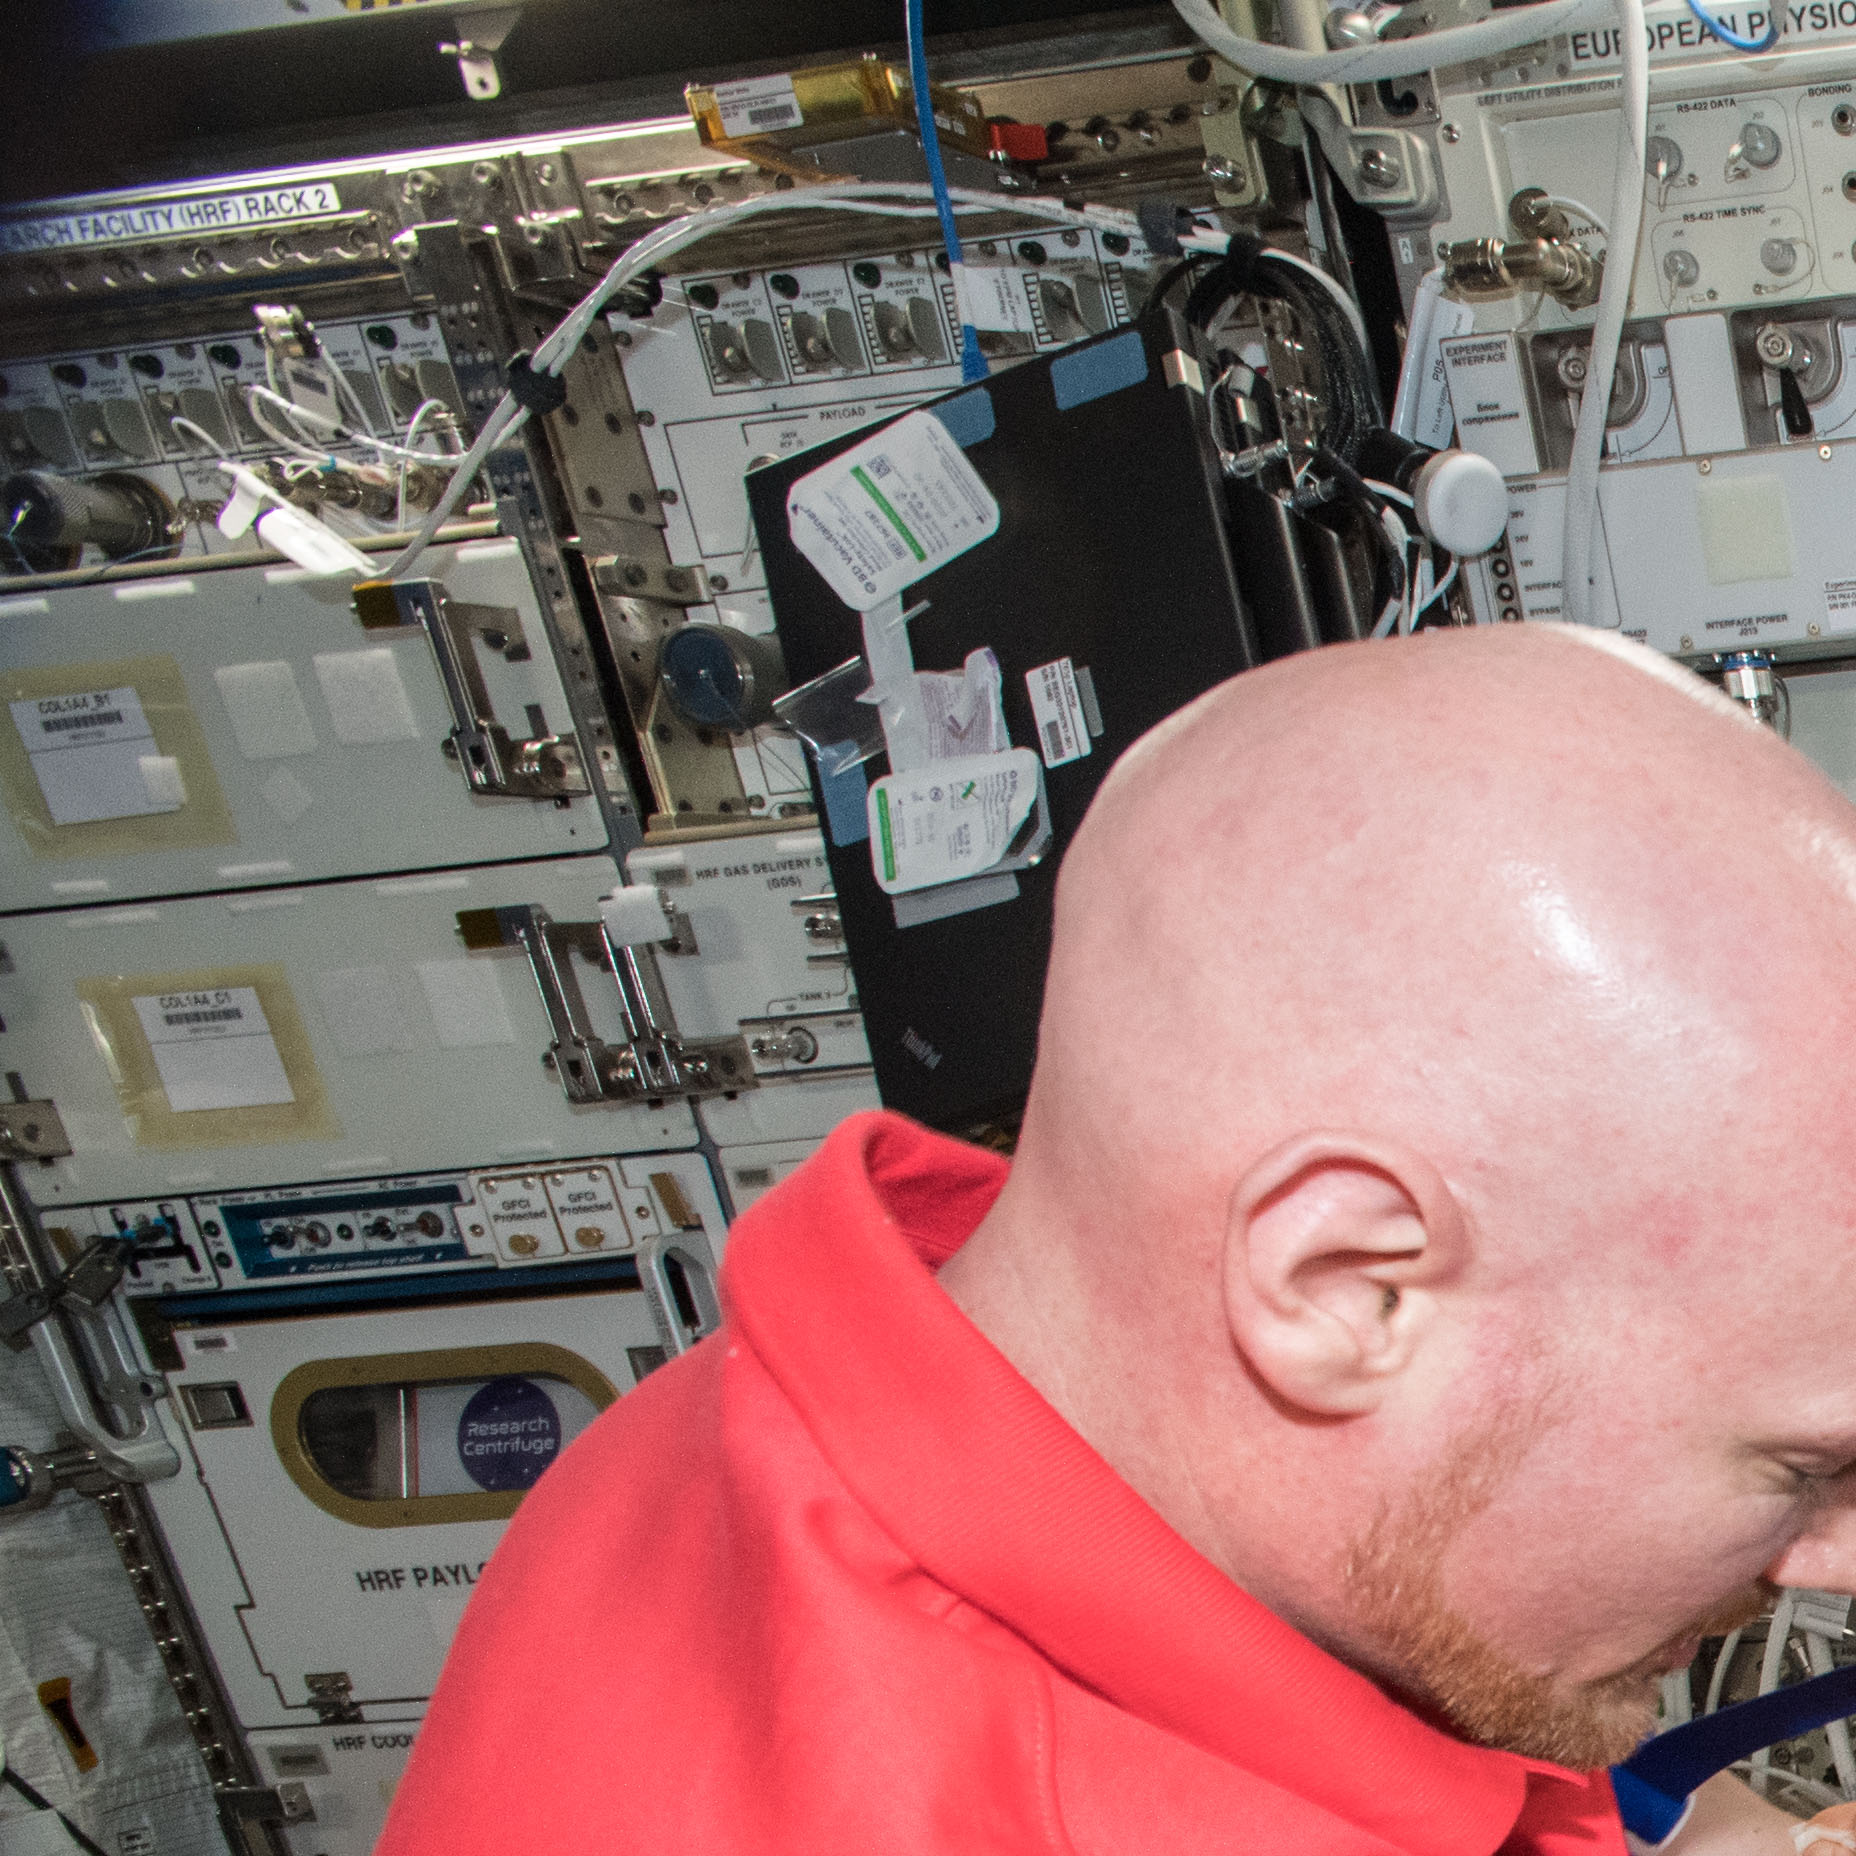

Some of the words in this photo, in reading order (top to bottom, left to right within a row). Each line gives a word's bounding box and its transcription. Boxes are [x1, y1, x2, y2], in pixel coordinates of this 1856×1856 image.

[1543, 80, 1615, 98] DISTRIBUTION
[1808, 84, 1852, 98] BONDING
[1677, 101, 1707, 114] RS-422
[1710, 98, 1737, 110] DATA
[78, 208, 175, 240] FACILITY
[181, 200, 242, 229] (HRF)
[245, 191, 310, 221] RACK
[314, 188, 329, 211] 2
[1683, 212, 1713, 224] RS-422
[1716, 208, 1738, 221] TIME
[1740, 204, 1766, 217] SYNC
[1446, 340, 1508, 357] EXPERIMENT
[1452, 353, 1507, 367] INTERFACE
[819, 406, 866, 421] PAYLOAD
[1506, 484, 1537, 495] POWER
[800, 506, 858, 566] Vacutainer
[1705, 619, 1753, 630] INTERFACE
[1757, 614, 1788, 626] POWER
[696, 867, 719, 880] HRF
[724, 864, 749, 878] GAS
[753, 858, 811, 875] DELIVERY
[502, 1199, 532, 1214] GFCI
[567, 1190, 597, 1206] GFCI
[494, 1207, 548, 1224] Protected
[560, 1200, 614, 1217] Protected
[468, 1415, 550, 1436] Research
[463, 1434, 556, 1457] Centrifuge
[356, 1569, 406, 1592] HRF
[332, 1735, 366, 1752] HRF
